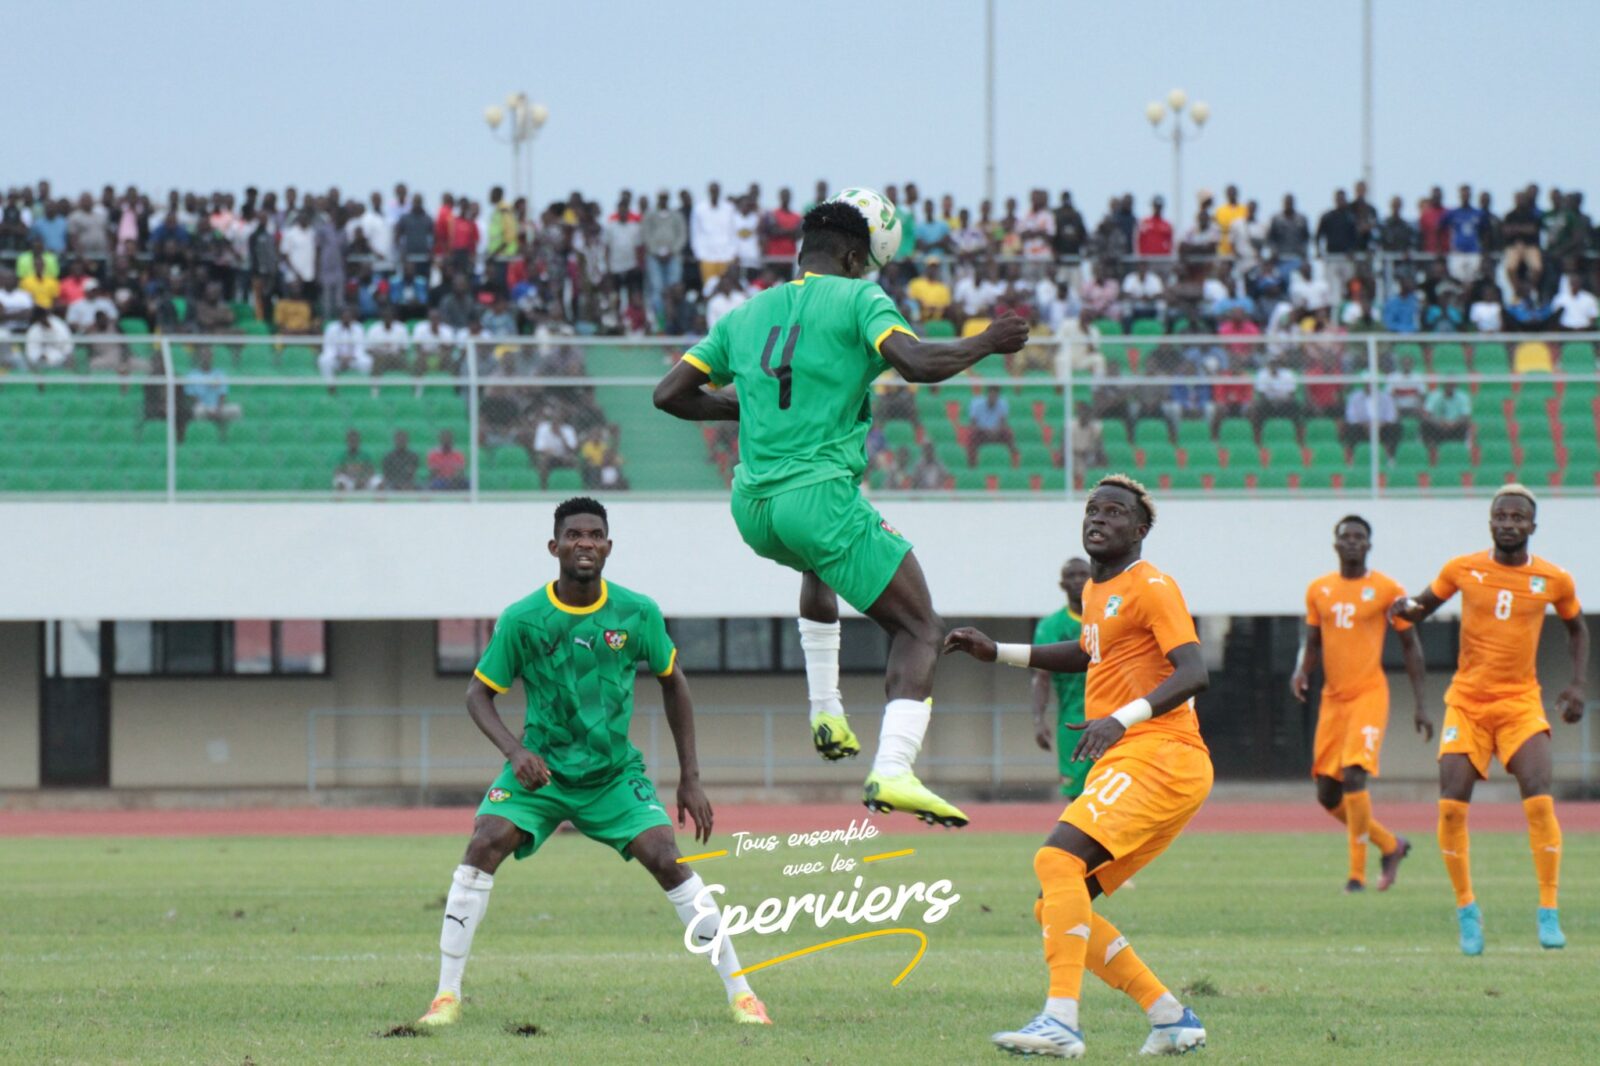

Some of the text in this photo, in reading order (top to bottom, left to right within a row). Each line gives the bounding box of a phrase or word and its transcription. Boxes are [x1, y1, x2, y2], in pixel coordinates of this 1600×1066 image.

[760, 325, 801, 410] 4
[1331, 602, 1356, 629] 12
[1495, 589, 1513, 620] 8
